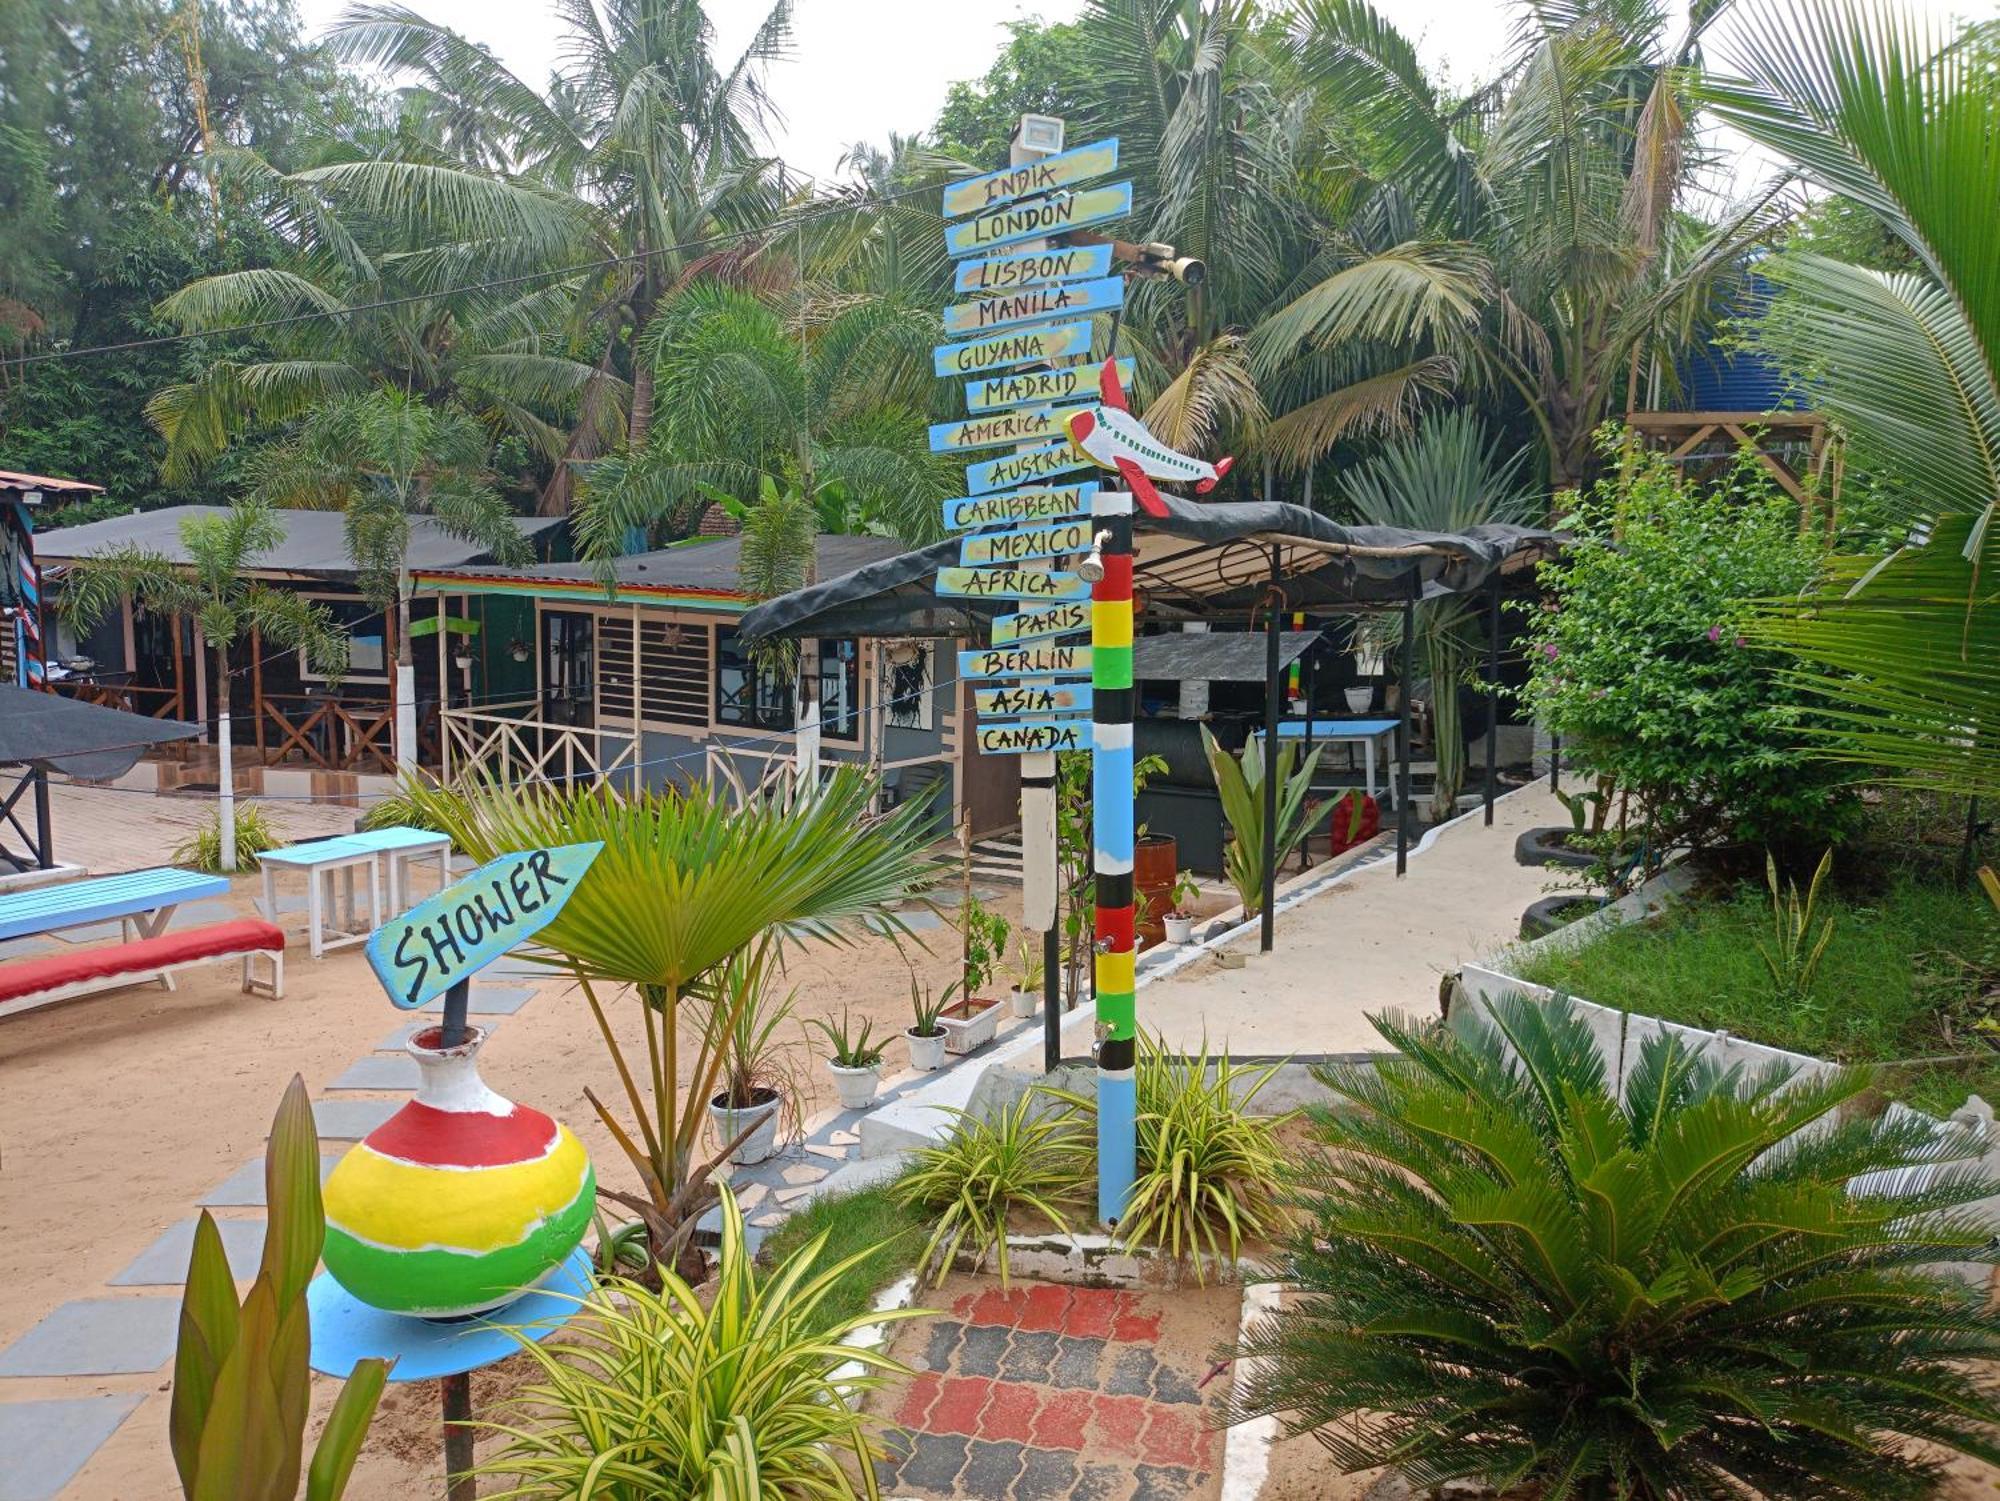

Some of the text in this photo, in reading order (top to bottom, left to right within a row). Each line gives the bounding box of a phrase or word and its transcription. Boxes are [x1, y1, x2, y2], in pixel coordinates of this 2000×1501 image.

[984, 164, 1057, 205] INDIA
[974, 197, 1074, 243] LONDON
[980, 251, 1075, 288] LISBON
[979, 289, 1071, 326] MANILA
[957, 335, 1044, 371] GUYANA
[984, 368, 1077, 405] MADRID
[958, 412, 1050, 445] AMERICA
[954, 488, 1081, 526] CARIBBEAN
[990, 526, 1081, 562] MEXICO
[962, 570, 1058, 595] AFRICA
[1013, 605, 1085, 637] PARIS
[982, 647, 1074, 677] BERLIN
[989, 687, 1055, 713] ASIA
[983, 725, 1078, 751] CANADA
[394, 850, 569, 1003] SHOWER
